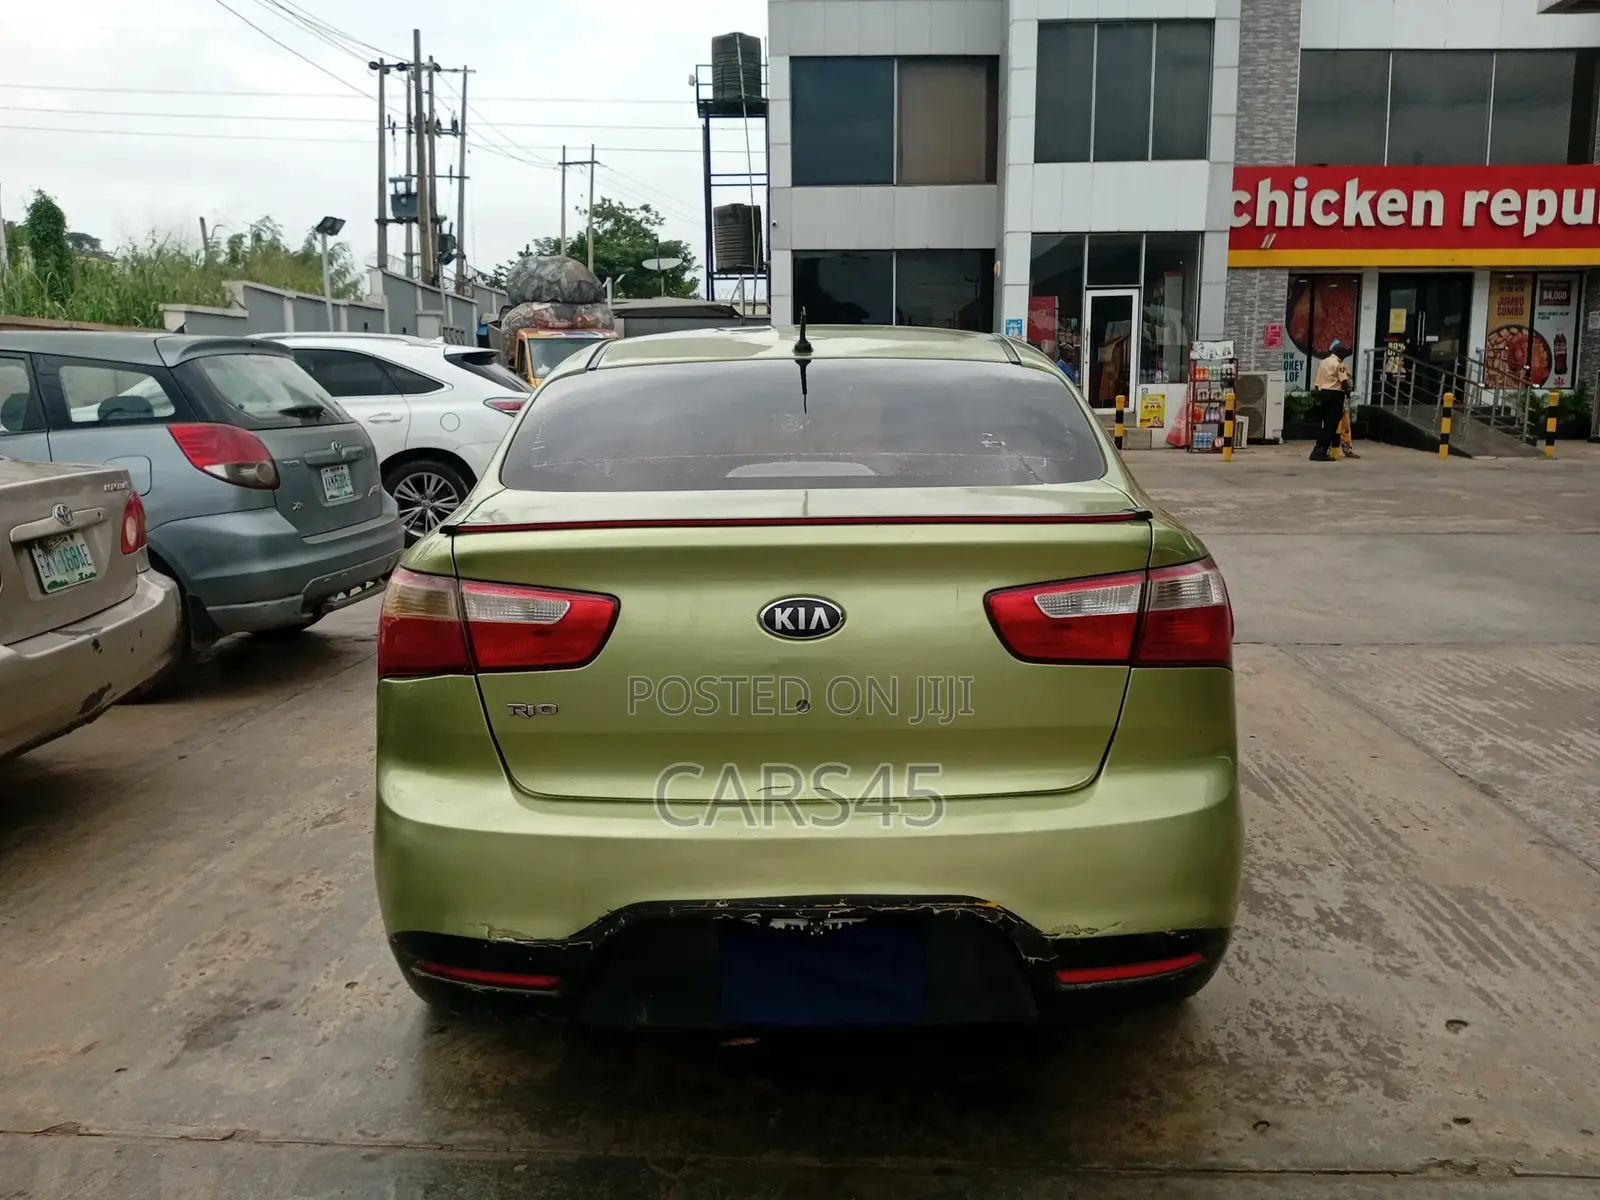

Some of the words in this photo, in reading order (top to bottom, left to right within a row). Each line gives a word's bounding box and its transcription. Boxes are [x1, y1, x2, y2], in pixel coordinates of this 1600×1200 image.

[1229, 176, 1444, 228] chicken
[1463, 188, 1596, 238] repu
[1497, 296, 1525, 306] JUMBO
[1496, 306, 1524, 316] COMBO
[774, 606, 831, 630] KIA
[507, 703, 559, 720] RIO
